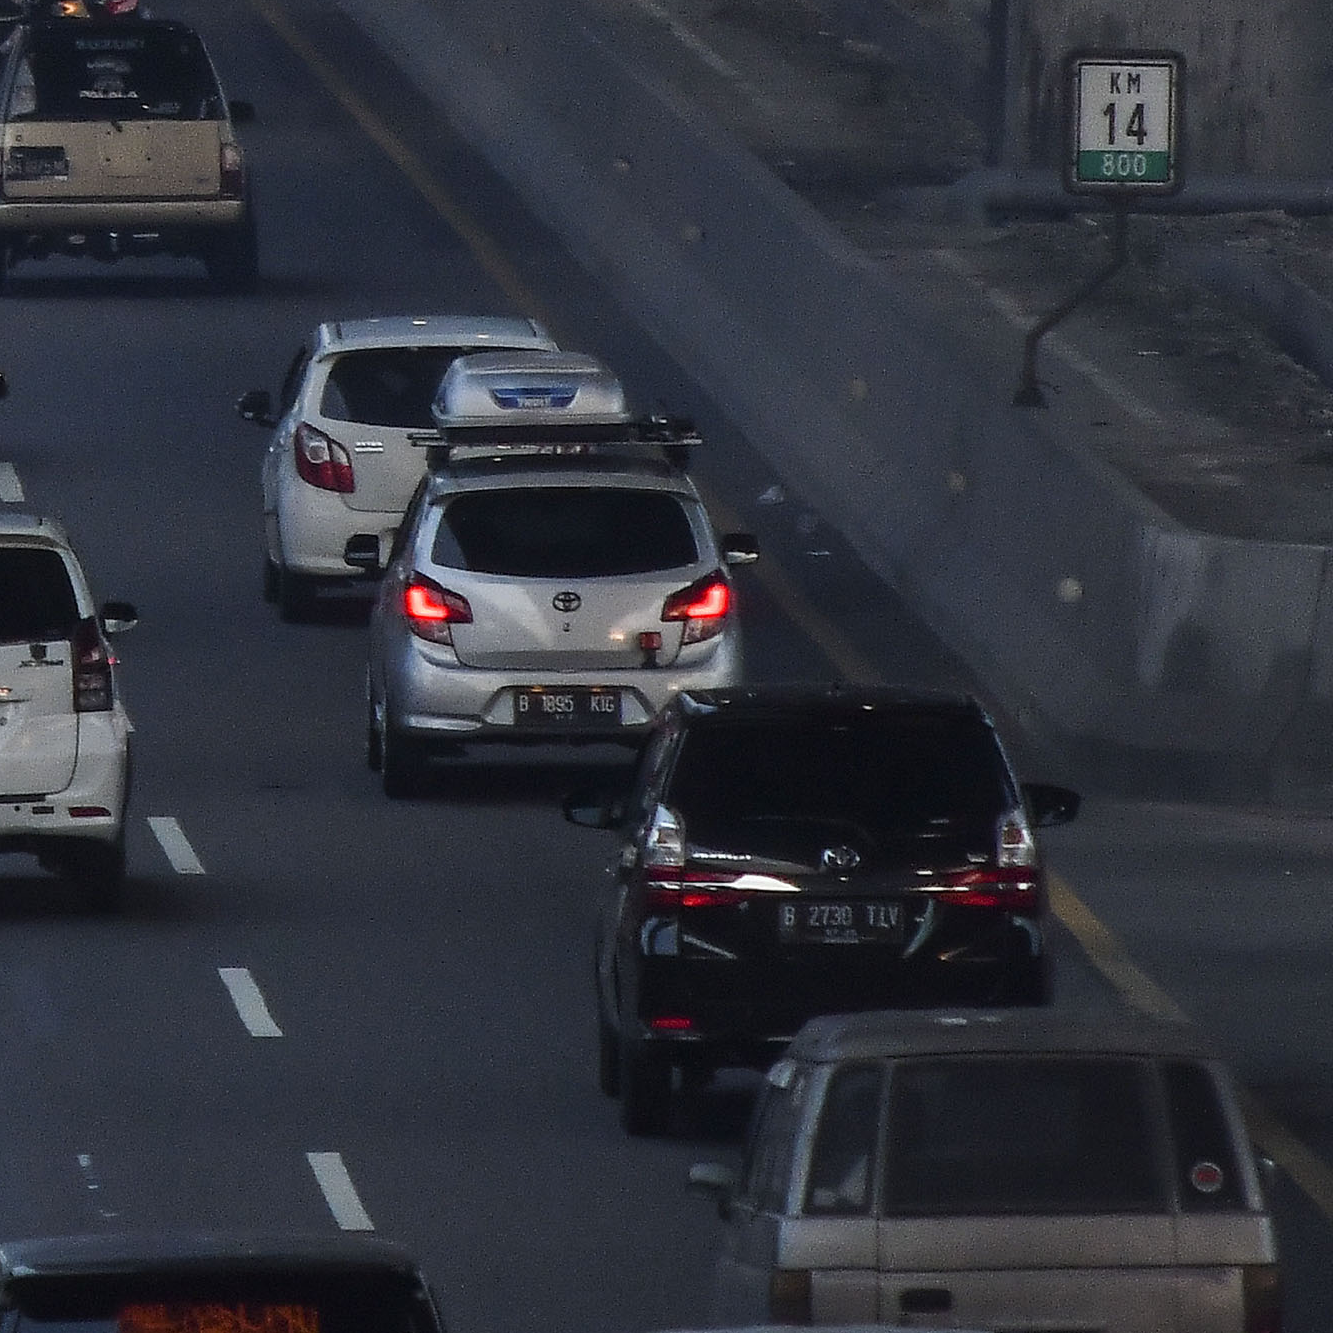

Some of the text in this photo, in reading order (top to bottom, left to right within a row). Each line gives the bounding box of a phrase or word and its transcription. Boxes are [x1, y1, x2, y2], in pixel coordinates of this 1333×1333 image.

[1110, 72, 1141, 94] KM
[1103, 102, 1148, 145] 14
[1103, 154, 1147, 176] 800
[518, 694, 530, 712] B
[784, 905, 795, 925] B
